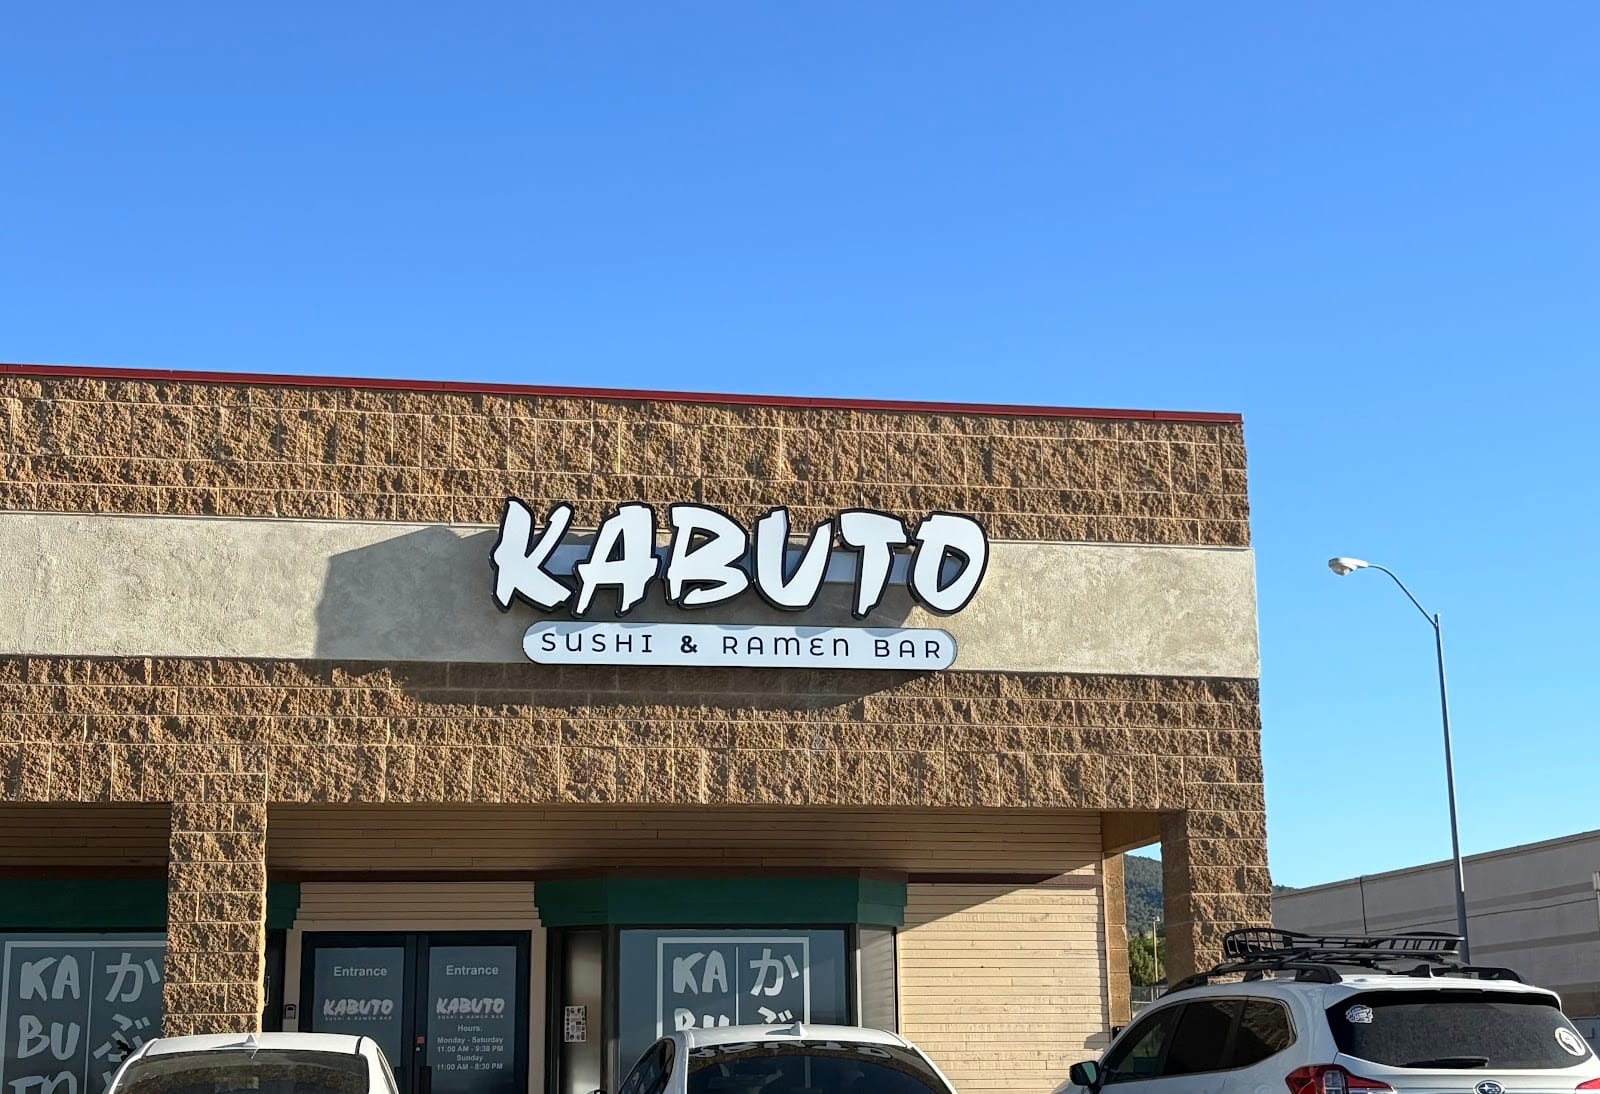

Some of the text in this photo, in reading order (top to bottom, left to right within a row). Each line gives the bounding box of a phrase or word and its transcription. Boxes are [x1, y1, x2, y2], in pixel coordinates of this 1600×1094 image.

[489, 496, 990, 618] KABUTO
[540, 632, 942, 659] SUSHI & RAMEN BAR
[19, 954, 81, 1002] KA
[333, 966, 388, 977] Entrance
[445, 964, 499, 976] Entrance
[672, 950, 729, 996] KA
[323, 998, 394, 1016] KABUTO
[436, 997, 505, 1015] KABUTO
[17, 1014, 81, 1061] BU
[437, 1036, 466, 1045] Monday
[471, 1036, 504, 1044] Saturday
[456, 1055, 483, 1063] Sunday
